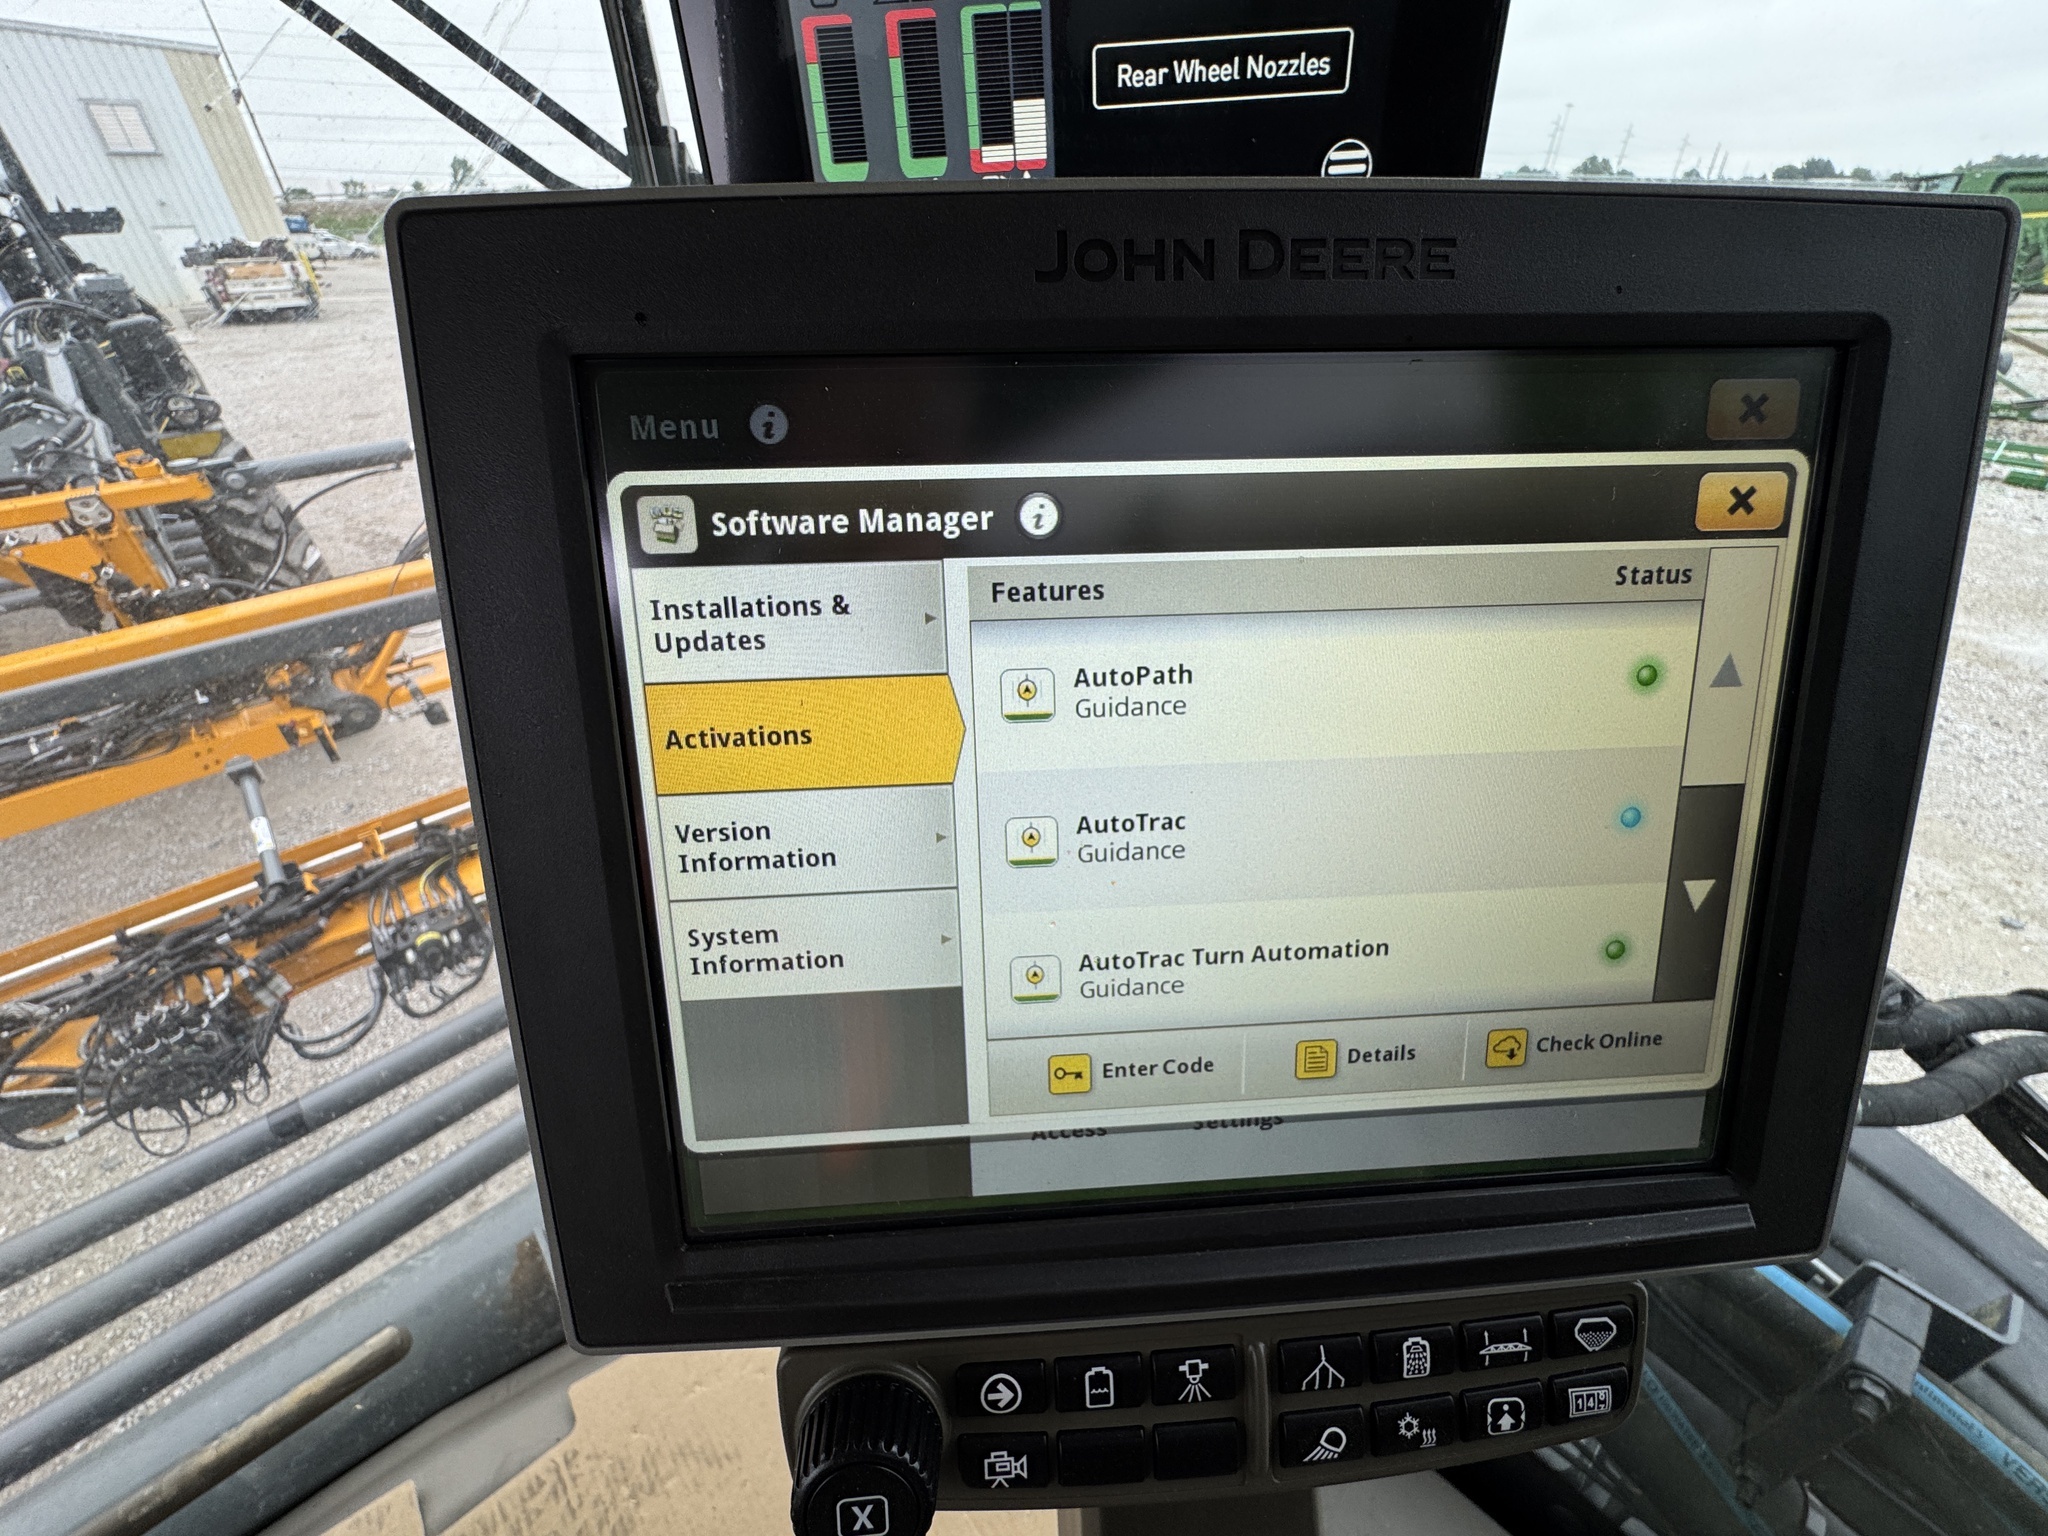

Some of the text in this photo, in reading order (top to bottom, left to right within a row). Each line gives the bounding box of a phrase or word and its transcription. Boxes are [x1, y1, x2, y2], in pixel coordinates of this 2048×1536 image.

[1117, 51, 1331, 88] Rear Wheel Nozzles
[1033, 227, 1458, 282] JOHN DEERE
[630, 414, 719, 441] Menu
[711, 508, 994, 539] Software Manager
[1615, 565, 1693, 586] Status
[991, 581, 1105, 603] Features
[649, 594, 850, 621] Installations &
[654, 631, 766, 657] Updates
[1073, 663, 1193, 688] AutoPath
[1075, 696, 1187, 719] Guidance
[665, 725, 813, 751] Activations
[674, 824, 771, 844] Version
[1076, 813, 1186, 835] AutoTrac
[678, 847, 837, 874] Information
[1077, 841, 1186, 864] Guidance
[687, 928, 779, 952] System
[690, 947, 844, 976] Information
[1078, 942, 1389, 972] AutoTrac Turn Automation
[1080, 977, 1185, 999] Guidance
[1347, 1044, 1416, 1064] Details
[1536, 1031, 1663, 1053] Check Online
[1102, 1056, 1214, 1079] Enter Code
